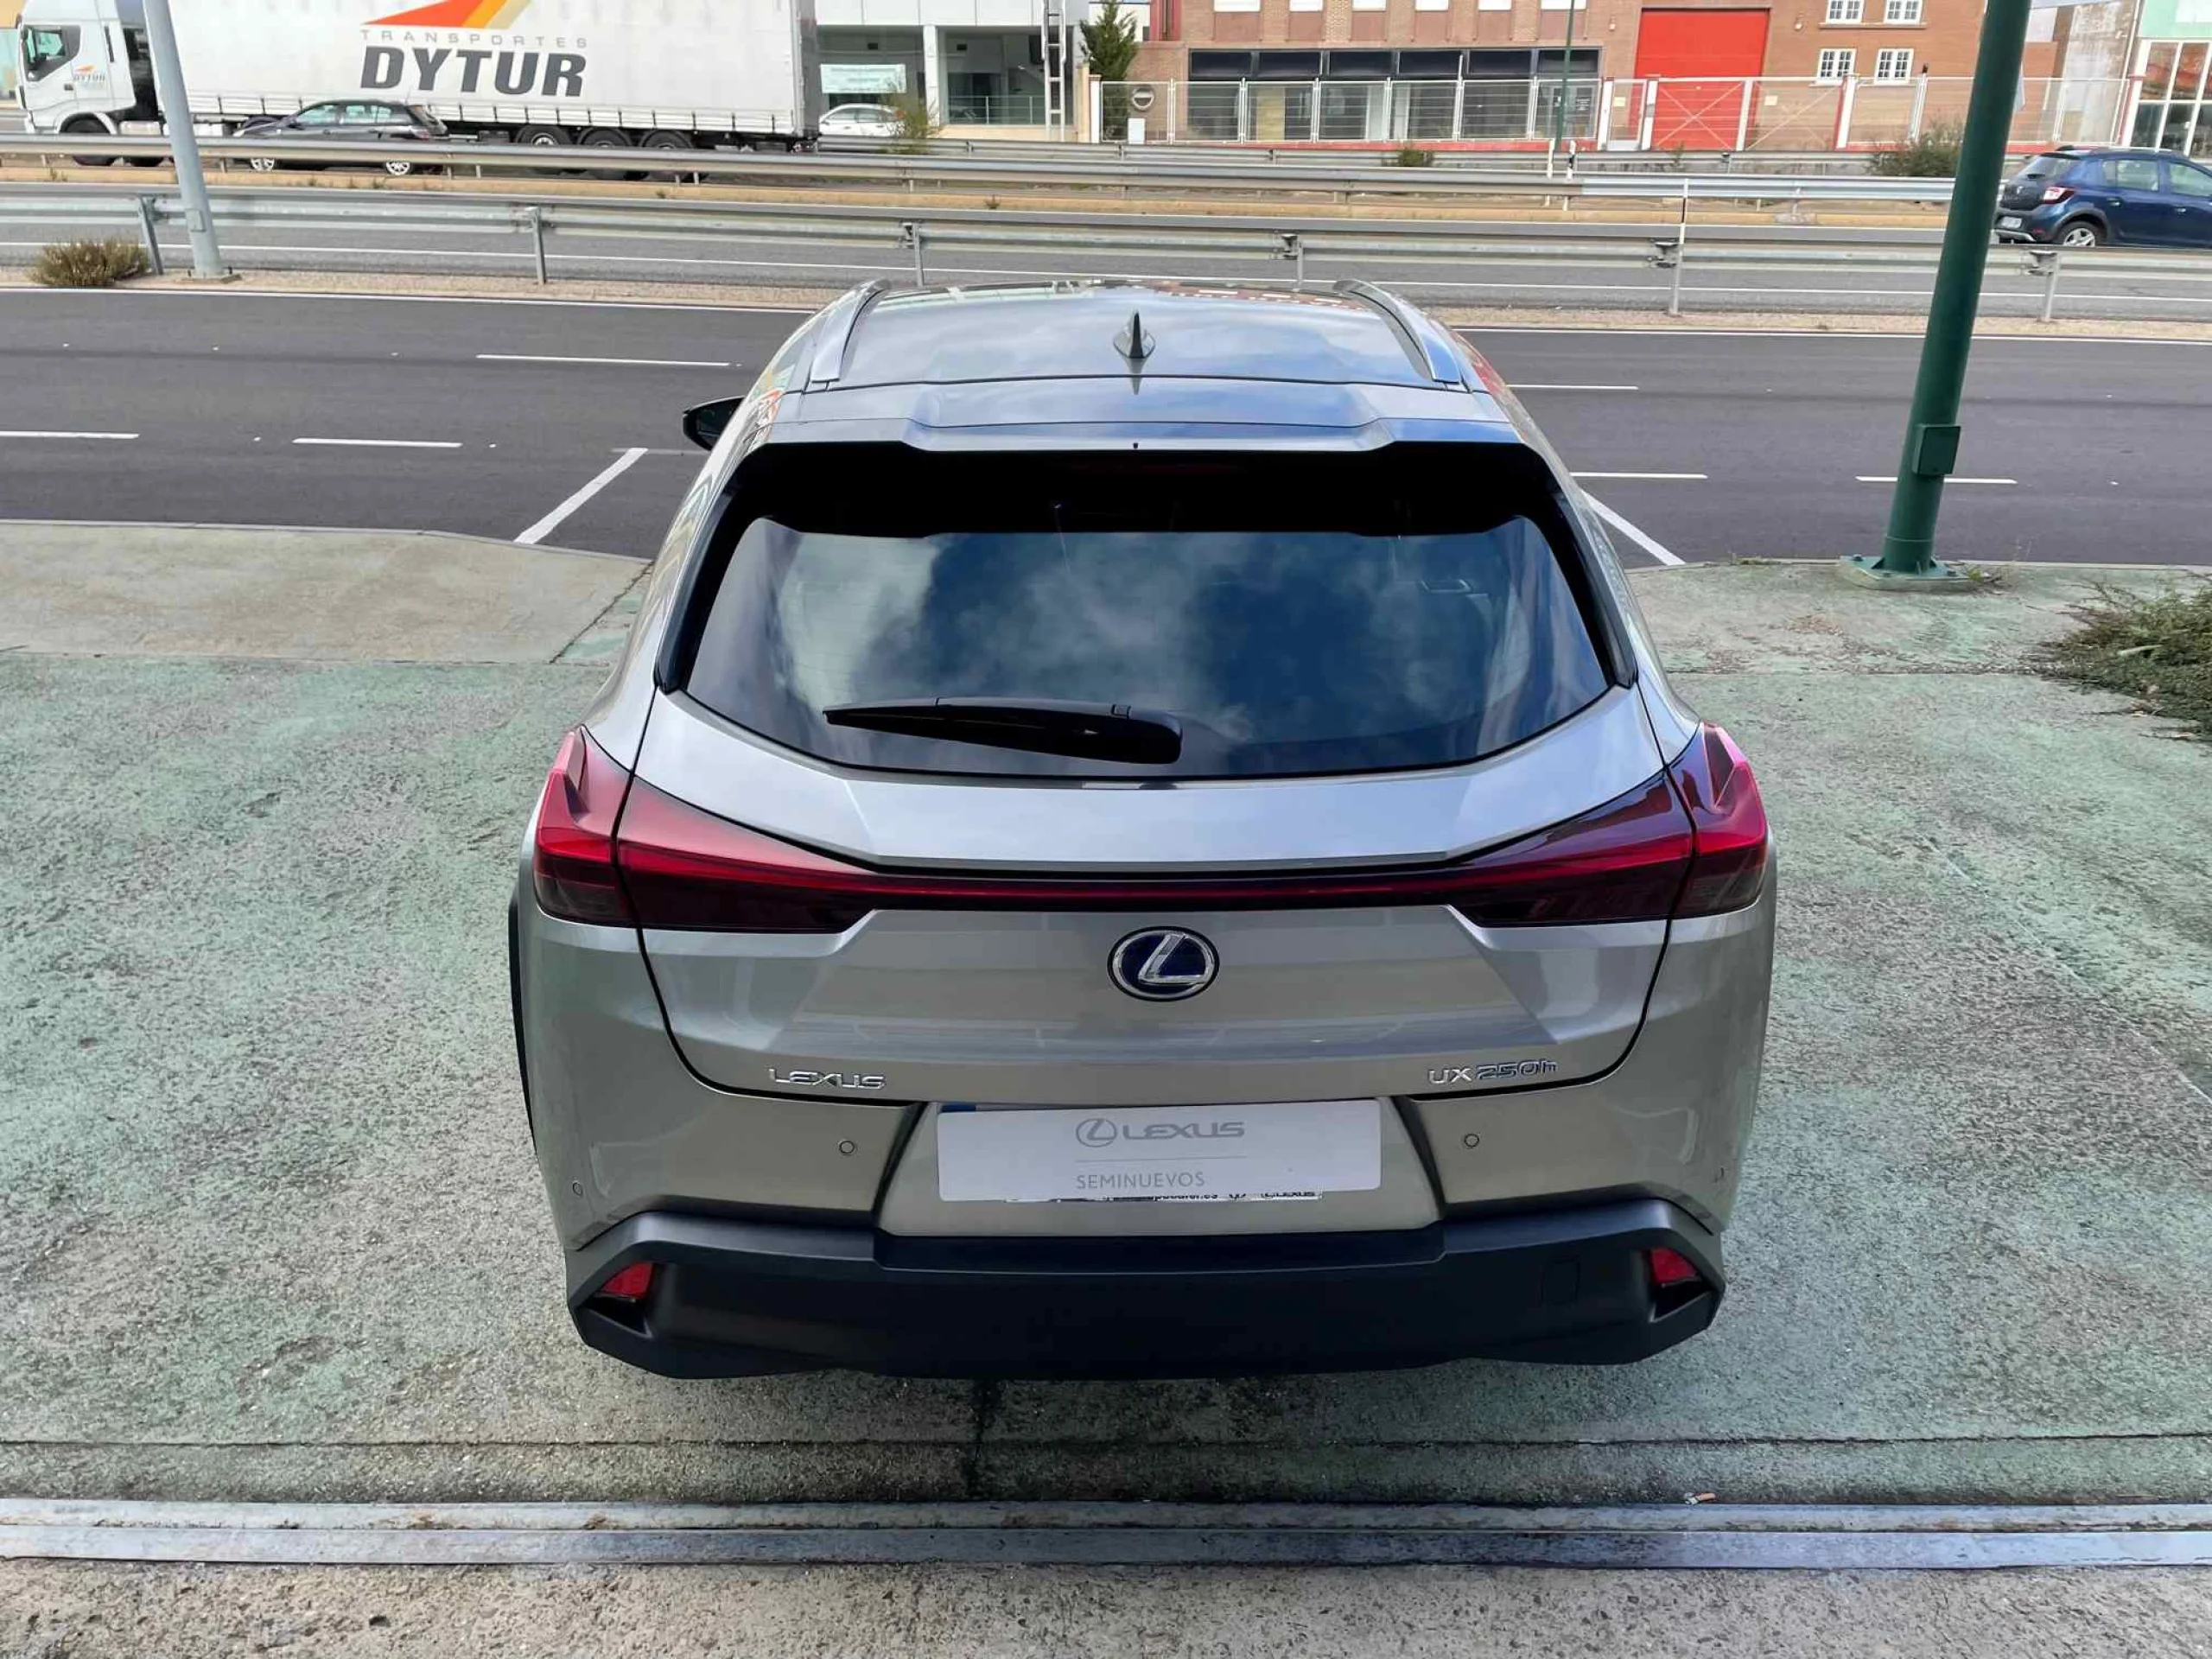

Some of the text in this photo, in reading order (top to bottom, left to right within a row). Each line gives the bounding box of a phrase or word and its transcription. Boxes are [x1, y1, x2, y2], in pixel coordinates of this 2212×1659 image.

[360, 29, 588, 48] TRANSPORTES
[360, 46, 587, 97] DYTUR
[769, 1067, 887, 1090] LEXUS
[1123, 1122, 1245, 1140] LEXUS
[1076, 1172, 1205, 1190] SEMINUEVOS
